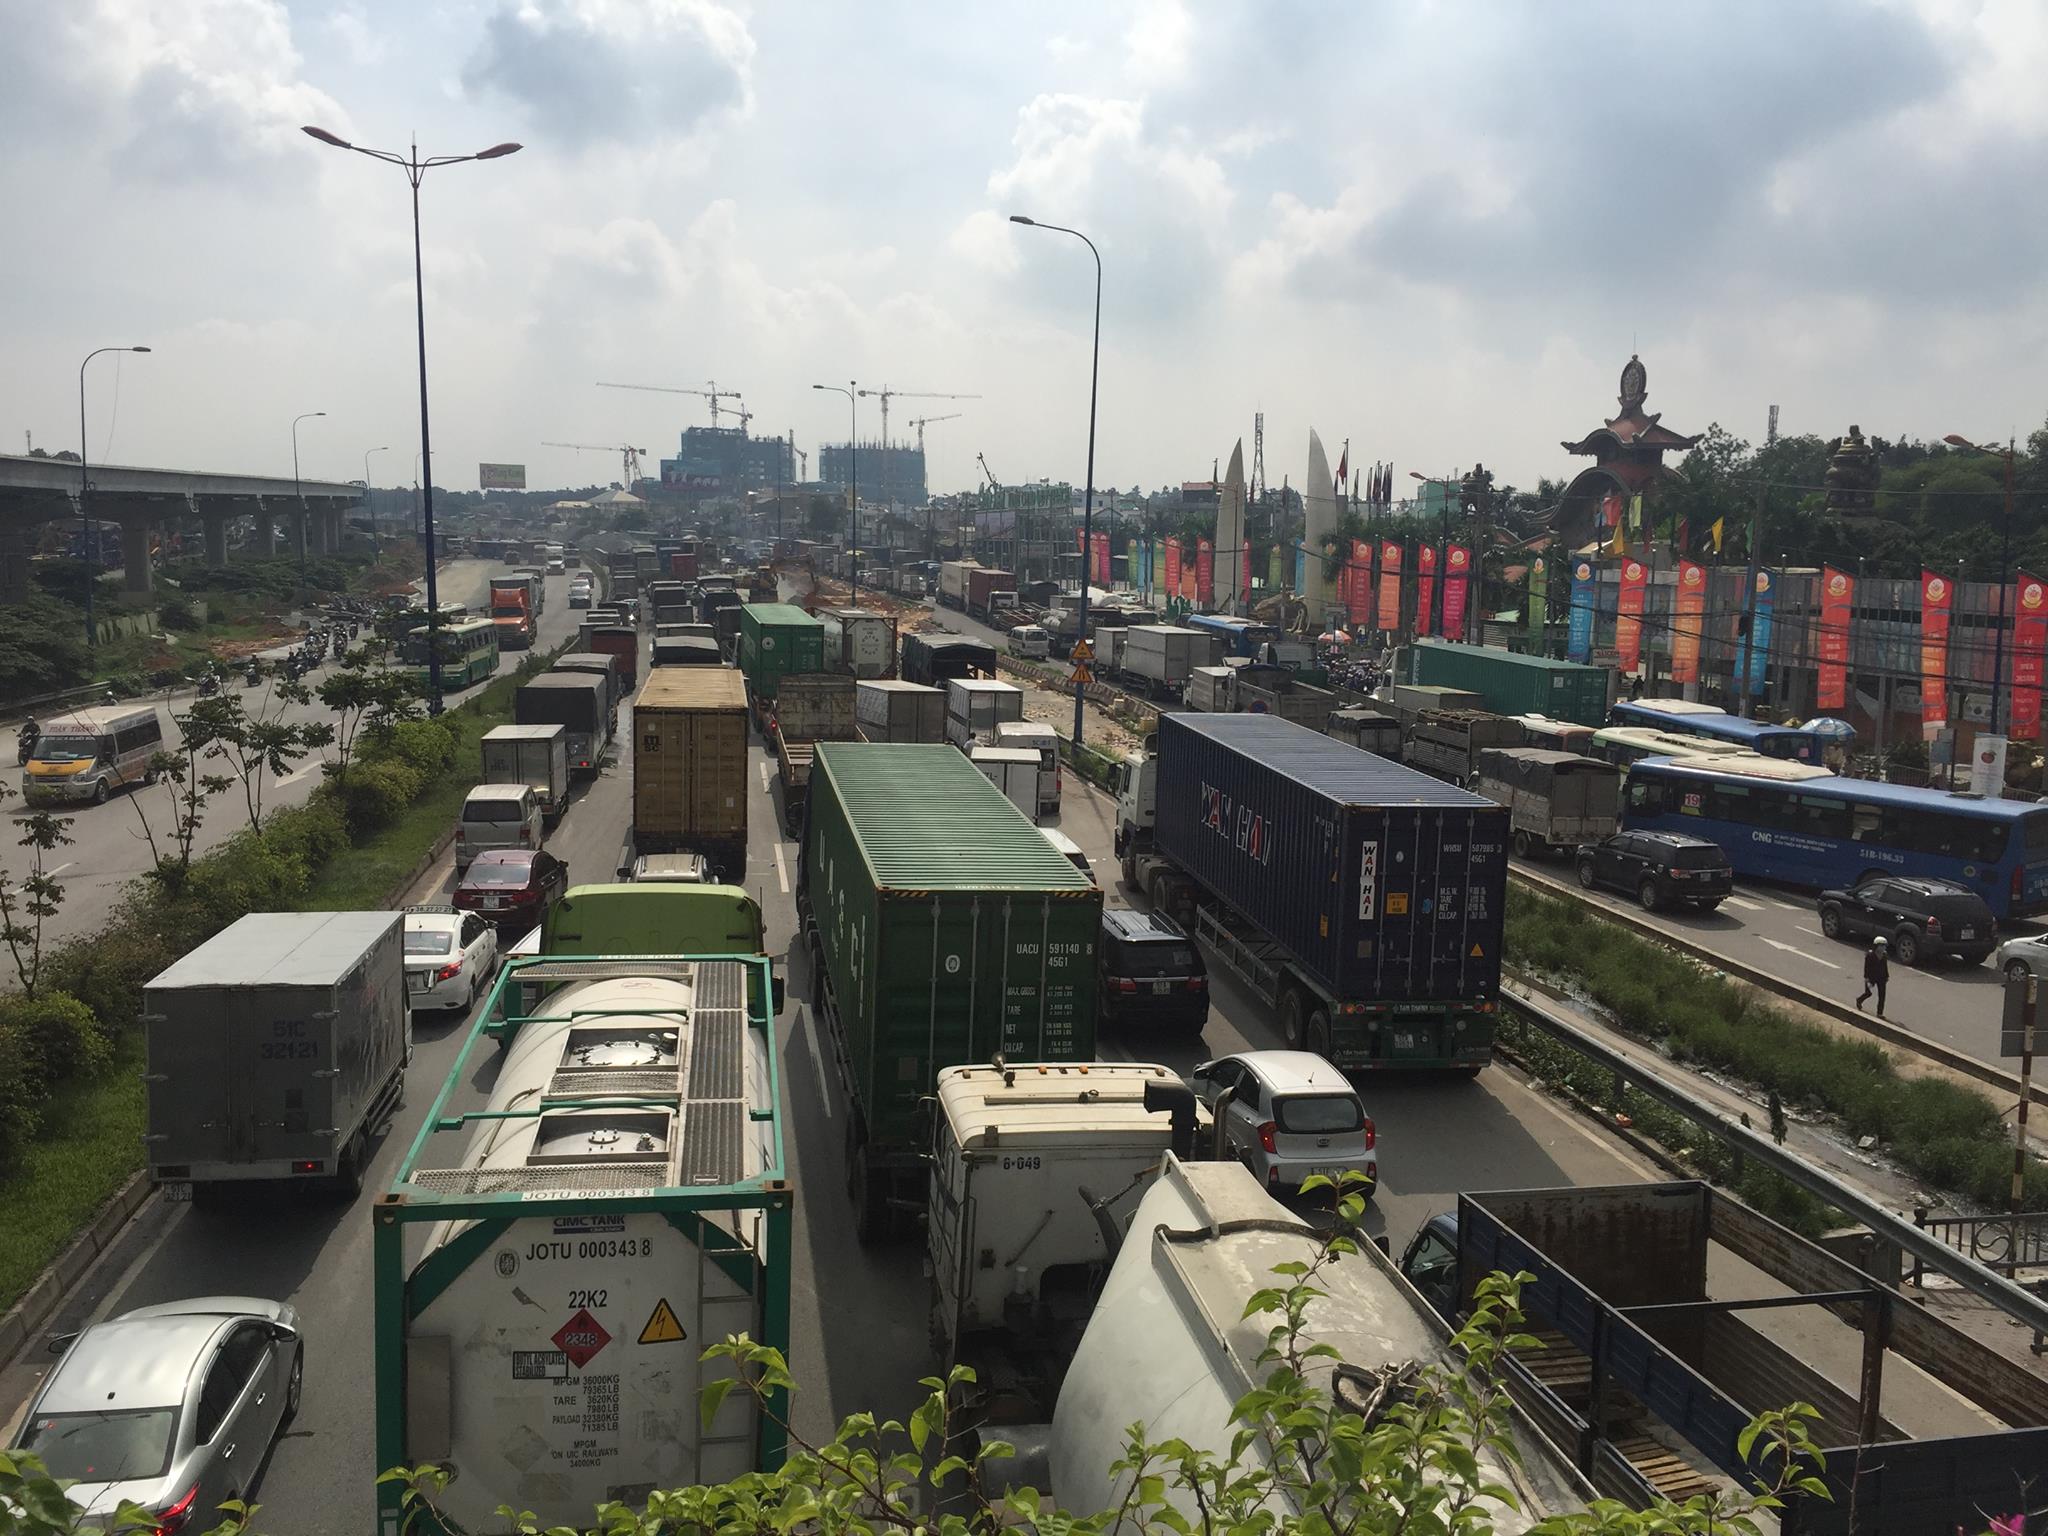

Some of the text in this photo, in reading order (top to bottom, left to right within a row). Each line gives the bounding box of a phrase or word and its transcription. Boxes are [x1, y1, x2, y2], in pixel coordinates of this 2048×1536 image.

[1685, 794, 1699, 807] 19
[1751, 830, 1772, 844] CNG
[1016, 943, 1039, 955] UACU
[1048, 943, 1080, 955] 591140
[1047, 956, 1069, 968] 45G1
[272, 1020, 306, 1037] 51C
[1005, 1023, 1017, 1035] NET
[525, 1188, 651, 1201] JOTU 000343 8
[553, 1214, 625, 1227] CIMC TANK
[525, 1238, 652, 1261] JOTU 000343 8
[567, 1289, 608, 1310] 22K2
[565, 1332, 597, 1346] 2348
[552, 1376, 580, 1386] MPGM
[553, 1395, 577, 1406] TARE
[552, 1415, 581, 1425] PAYLOAD
[573, 1440, 597, 1449] MPGM
[582, 1448, 619, 1458] RAILWAYS
